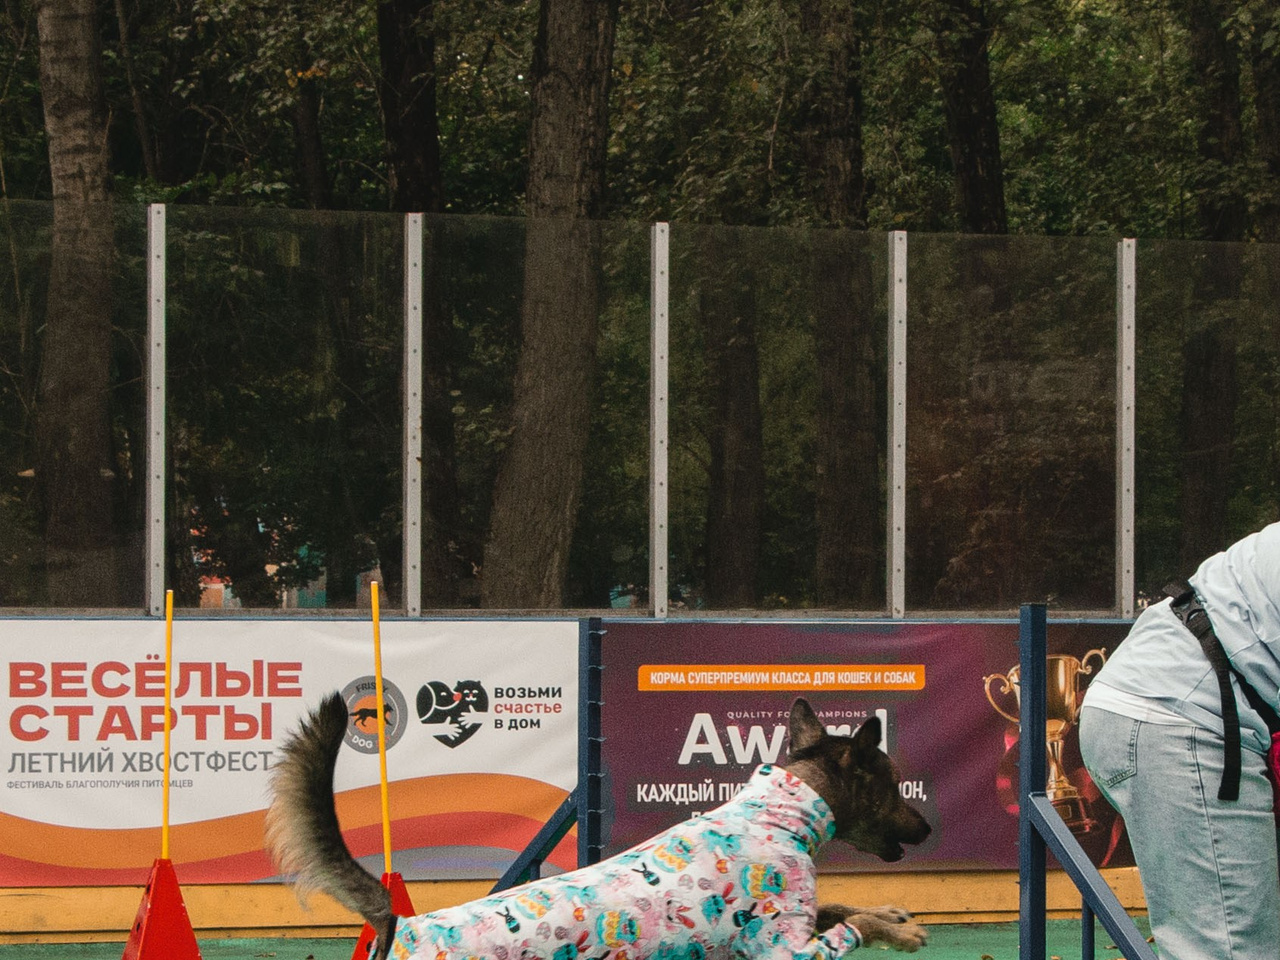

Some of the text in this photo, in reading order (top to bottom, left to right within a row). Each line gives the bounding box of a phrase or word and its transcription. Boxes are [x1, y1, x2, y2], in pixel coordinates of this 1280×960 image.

[9, 654, 303, 698] ВЕСЁЛЫЕ
[650, 671, 916, 685] КОРМА СУПЕРПРЕМИУМ КЛАССА ДЛЯ КОШЕК И СОБАК
[356, 682, 388, 693] FRISY
[494, 703, 562, 714] счастье
[727, 711, 773, 719] QUALITY
[9, 702, 273, 742] СТАРТЫ
[352, 735, 373, 749] DOG
[8, 747, 273, 773] ЛЕТНИЙ ХВОСТФЕСТ
[7, 780, 64, 789] ФЕСТИВАЛЬ
[66, 780, 140, 788] БЛАГОПОЛУЧИЯ
[637, 779, 715, 804] КАЖДЫЙ
